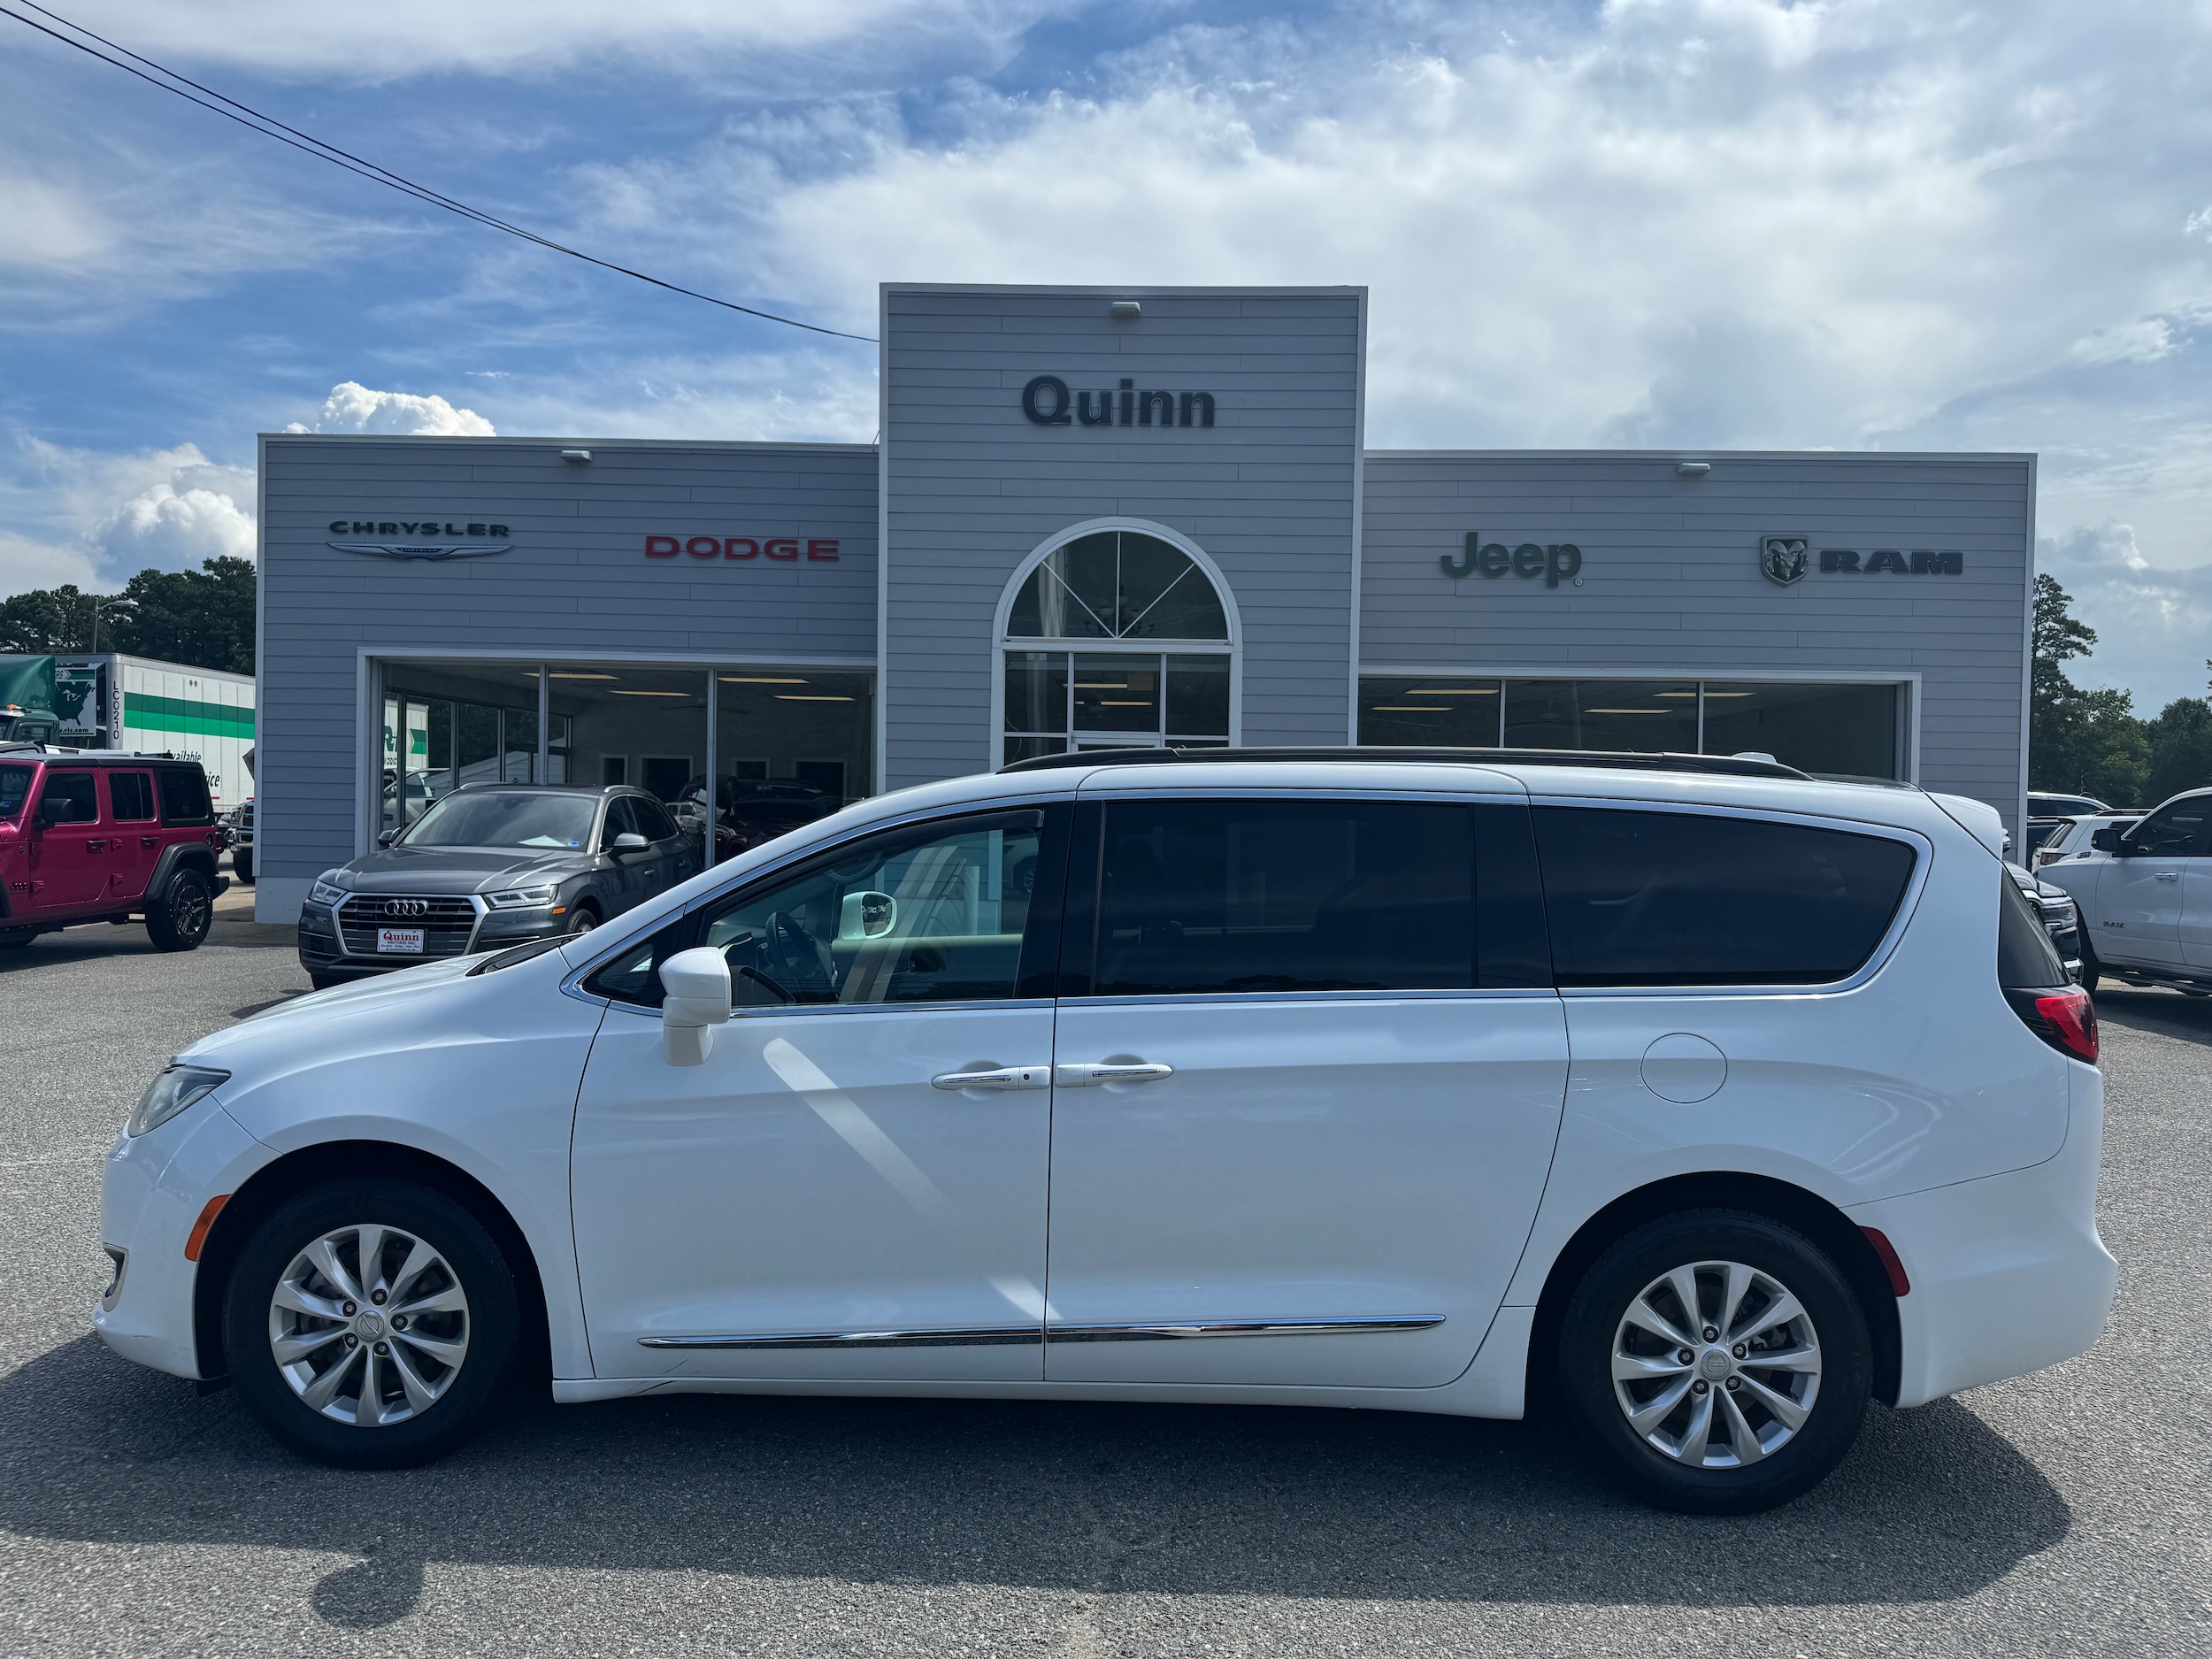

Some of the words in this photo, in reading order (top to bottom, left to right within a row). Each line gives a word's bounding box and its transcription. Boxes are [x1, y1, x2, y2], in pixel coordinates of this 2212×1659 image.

[1022, 375, 1216, 427] Quinn
[328, 520, 510, 537] CHRYSLER
[645, 535, 840, 562] DODGE
[1440, 531, 1583, 588] Jeep
[1820, 549, 1963, 575] RAM
[166, 749, 203, 763] vailable
[383, 932, 419, 941] Quinn
